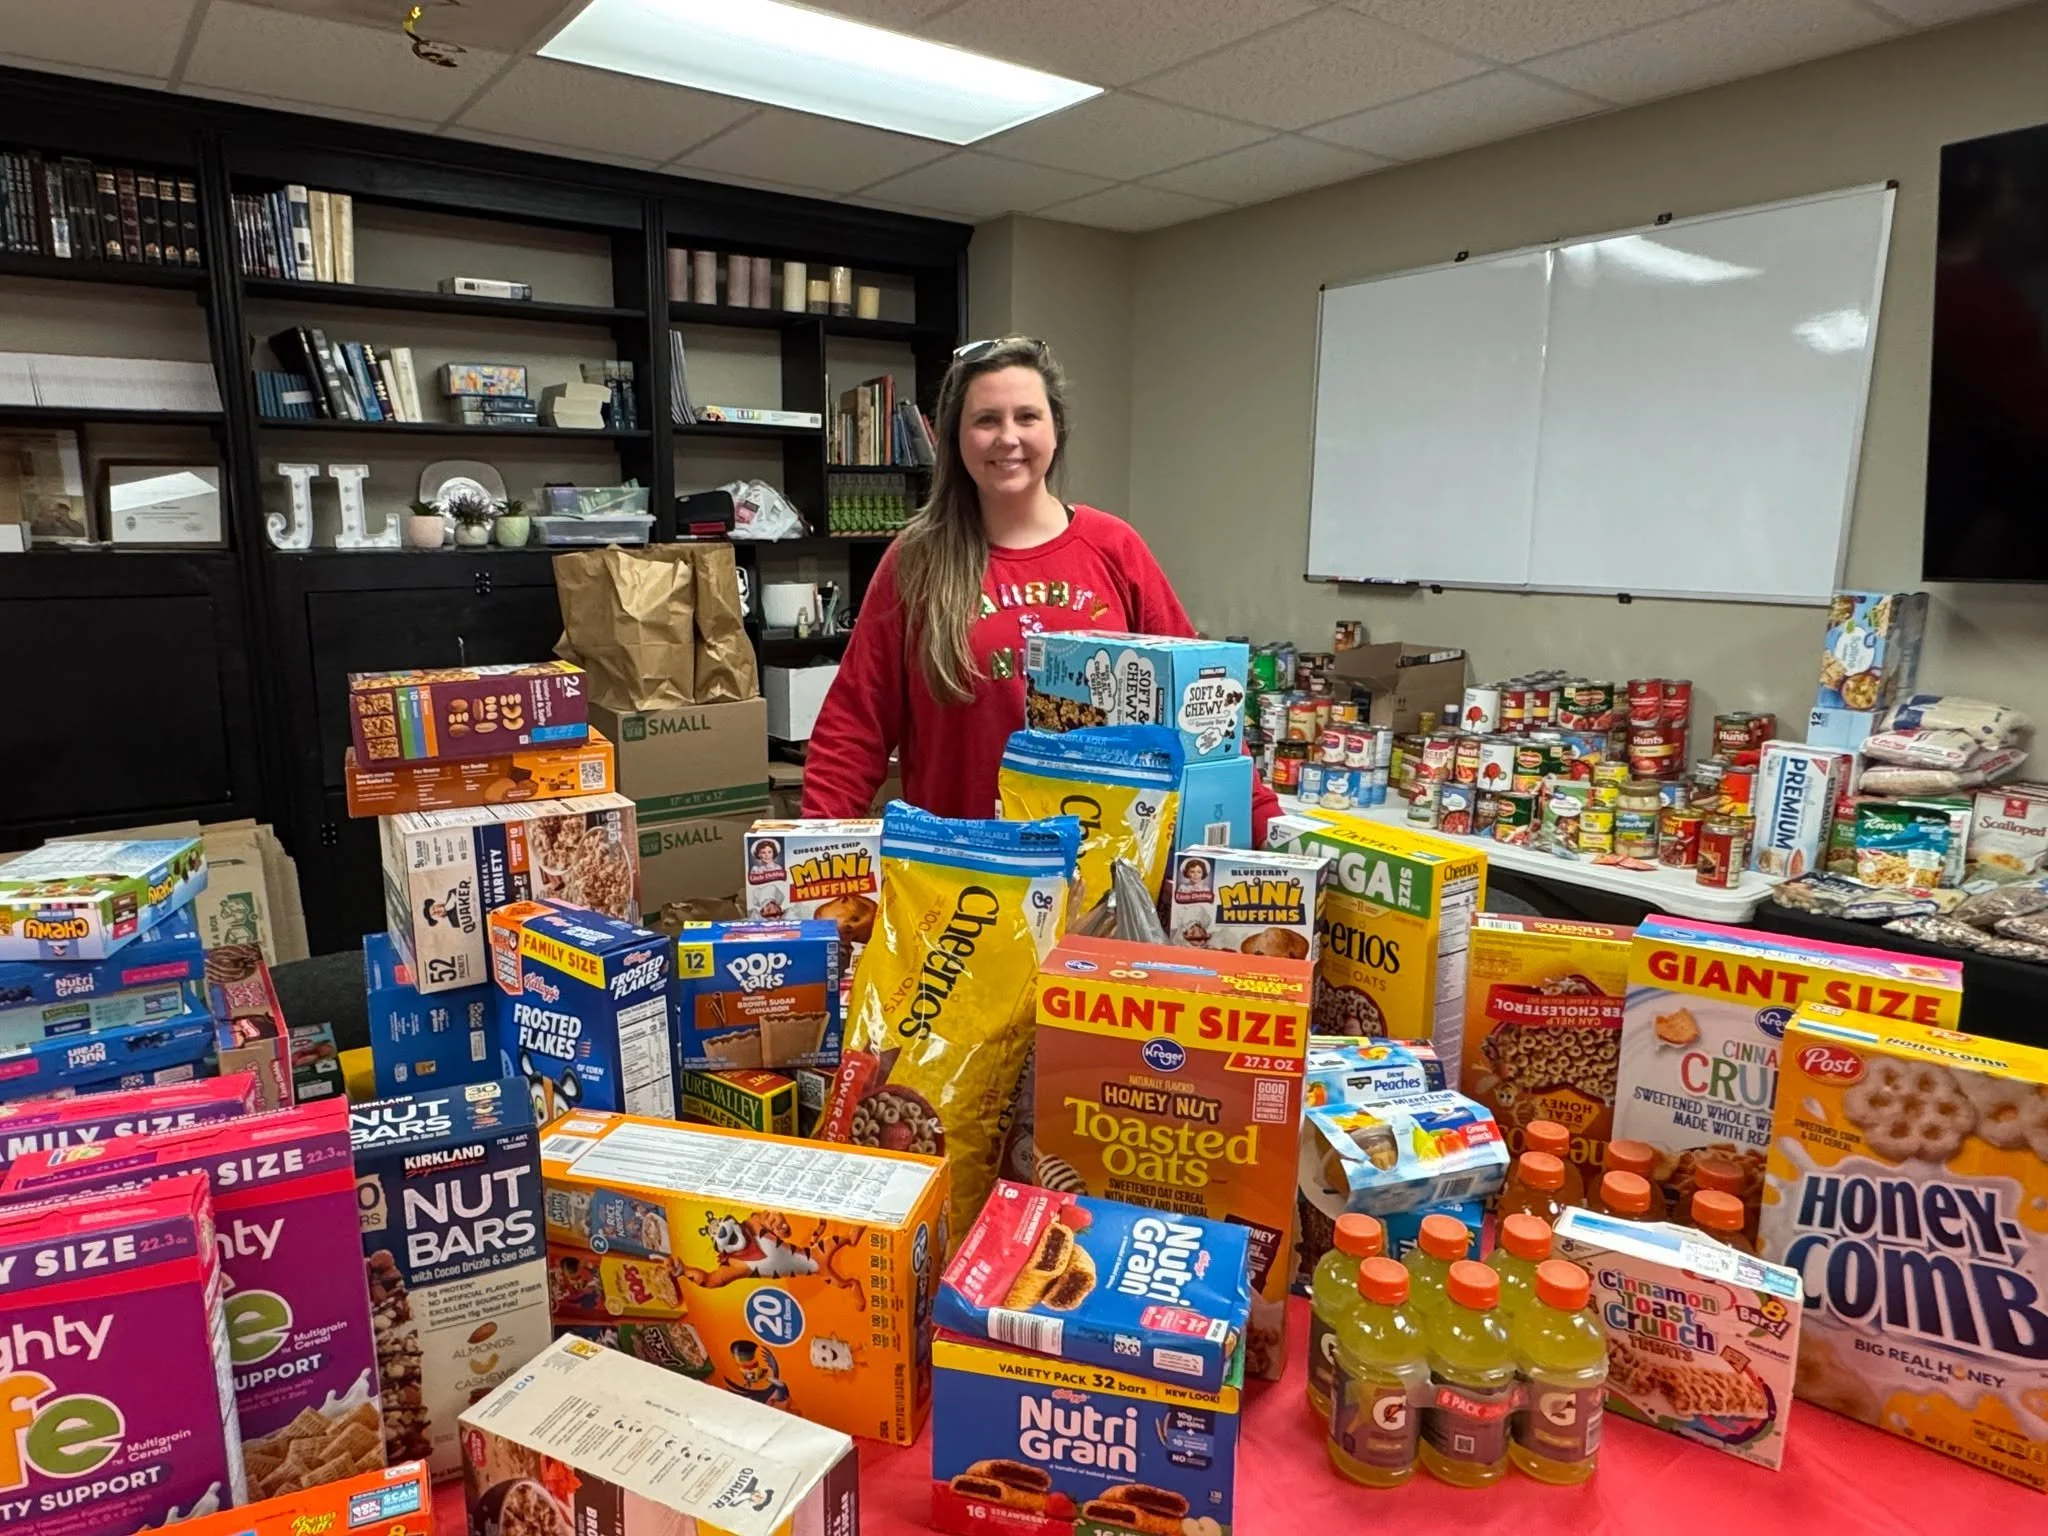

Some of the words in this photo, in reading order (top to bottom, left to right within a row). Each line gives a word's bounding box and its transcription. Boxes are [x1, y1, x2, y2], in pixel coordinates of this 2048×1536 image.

[980, 581, 1108, 621] AUGHTY
[563, 675, 581, 698] 24
[1126, 662, 1138, 723] CHEWY
[1139, 669, 1151, 707] SOFT
[1190, 686, 1214, 701] SOFT
[1215, 685, 1224, 699] &
[1185, 700, 1223, 717] CHEWY
[1811, 712, 1821, 726] 12
[648, 715, 711, 736] SMALL
[1775, 757, 1808, 849] PREMIUM
[664, 826, 723, 849] SMALL
[1864, 818, 1904, 831] Knorr
[1980, 815, 2047, 838] Scalloped
[793, 844, 839, 855] CHOCOLATE
[482, 863, 491, 904] OATMEAL
[491, 849, 505, 902] VARIETY
[1231, 868, 1289, 877] BLUEBERRY
[1288, 838, 1395, 904] MEGA
[1399, 867, 1413, 908] SIZE
[1444, 861, 1478, 881] Cheerios
[796, 878, 870, 899] MUFFINS
[459, 879, 472, 934] QUAKER
[1224, 909, 1301, 923] MUFFINS
[523, 934, 565, 962] FAMILY
[568, 954, 598, 976] SIZE
[685, 953, 705, 969] 12
[899, 885, 1000, 1041] Cheerios
[55, 973, 94, 989] Nutri
[429, 956, 457, 984] 52
[610, 955, 664, 990] FROSTED
[1353, 970, 1386, 991] OATS
[56, 982, 94, 997] Grain
[523, 972, 560, 1003] Kellogg's
[614, 969, 660, 1000] FLAKES
[1648, 951, 1809, 1004] GIANT
[1823, 980, 1941, 1027] SIZE
[737, 1000, 767, 1009] BROWN
[769, 997, 796, 1006] SUGAR
[745, 1005, 789, 1015] CINNAMON
[1496, 999, 1598, 1018] CHOLESTEROL
[514, 1003, 582, 1039] FROSTED
[1042, 986, 1184, 1034] GIANT
[1199, 1006, 1297, 1048] SIZE
[1547, 1015, 1575, 1025] HELP
[1578, 1017, 1601, 1026] CAN
[68, 1042, 105, 1058] Grain
[519, 1027, 576, 1060] FLAKES
[1145, 1044, 1183, 1066] Kroger
[68, 1051, 106, 1068] Nutri
[1244, 1055, 1270, 1069] 27.2
[1273, 1059, 1294, 1071] OZ
[1804, 1048, 1855, 1074] Post
[471, 1084, 497, 1095] 30
[837, 1059, 856, 1111] LOWER
[1258, 1082, 1285, 1094] GOOD
[1374, 1075, 1421, 1092] Peaches
[1681, 1052, 1776, 1112] CRU
[351, 1096, 413, 1109] KIRKLAND
[711, 1080, 760, 1127] VALLEY
[1105, 1085, 1167, 1113] HONEY
[1177, 1096, 1218, 1121] NUT
[1392, 1094, 1427, 1106] Mixed
[1539, 1099, 1593, 1115] HONEY
[1634, 1086, 1703, 1114] SWEETENED
[1707, 1103, 1750, 1127] WHOLE
[350, 1099, 449, 1128] NUT
[1549, 1109, 1582, 1124] REAL
[1673, 1111, 1703, 1133] MADE
[1713, 1120, 1744, 1141] WITH
[351, 1115, 452, 1143] BARS
[1064, 1097, 1260, 1165] Toasted
[0, 1129, 102, 1163] AMILY
[404, 1144, 485, 1170] KIRKLAND
[218, 1148, 304, 1186] SIZE
[306, 1147, 336, 1165] 22.3
[1102, 1143, 1209, 1187] Oats
[403, 1165, 531, 1229] NUT
[1108, 1178, 1157, 1197] SWEETENED
[1158, 1187, 1173, 1199] OAT
[1175, 1189, 1205, 1206] CEREAL
[605, 1203, 615, 1226] RICE
[613, 1199, 626, 1237] KRISPIES
[1173, 1201, 1208, 1217] NATURAL
[407, 1210, 536, 1268] BARS
[35, 1235, 137, 1277] SIZE
[140, 1233, 174, 1252] 22.3
[411, 1270, 432, 1283] with
[434, 1265, 460, 1280] Cocoa
[462, 1258, 491, 1274] Drizzle
[493, 1256, 500, 1265] &
[501, 1252, 518, 1264] Sea
[518, 1245, 537, 1259] Salt
[1118, 1218, 1166, 1296] Grain
[1148, 1222, 1203, 1306] Nutri
[429, 1301, 473, 1316] EXCELLENT
[475, 1294, 507, 1306] SOURCE
[442, 1290, 483, 1304] ARTIFICIAL
[486, 1280, 519, 1293] FLAVORS
[753, 1294, 783, 1338] 20
[1739, 1307, 1790, 1338] Bars!
[1761, 1301, 1786, 1322] 8
[294, 1321, 348, 1342] Multigrain
[1605, 1302, 1717, 1352] Crunch
[295, 1335, 331, 1352] Cereal
[453, 1336, 515, 1359] ALMONDS
[1854, 1339, 1885, 1357] BIG
[1888, 1348, 1933, 1370] REAL
[234, 1353, 322, 1391] UPPORT
[998, 1364, 1051, 1383] VARIETY
[1054, 1371, 1087, 1386] PACK
[1092, 1374, 1115, 1390] 32
[1118, 1382, 1147, 1395] bars
[1165, 1388, 1187, 1399] NEW
[1189, 1391, 1220, 1404] LOOK!
[1452, 1397, 1479, 1415] PACK
[1540, 1392, 1577, 1426] G
[1020, 1396, 1138, 1447] Nutri
[1177, 1419, 1205, 1430] grains
[1372, 1396, 1407, 1430] G
[127, 1428, 191, 1454] Multigrain
[128, 1443, 171, 1463] Cereal
[1019, 1431, 1137, 1473] Grain
[1171, 1454, 1186, 1463] NO
[40, 1466, 162, 1513] SUPPORT
[384, 1486, 418, 1502] SCAN
[711, 1468, 753, 1510] QUAKER
[966, 1505, 986, 1519] 16
[990, 1508, 1048, 1526] STRAWBERRY
